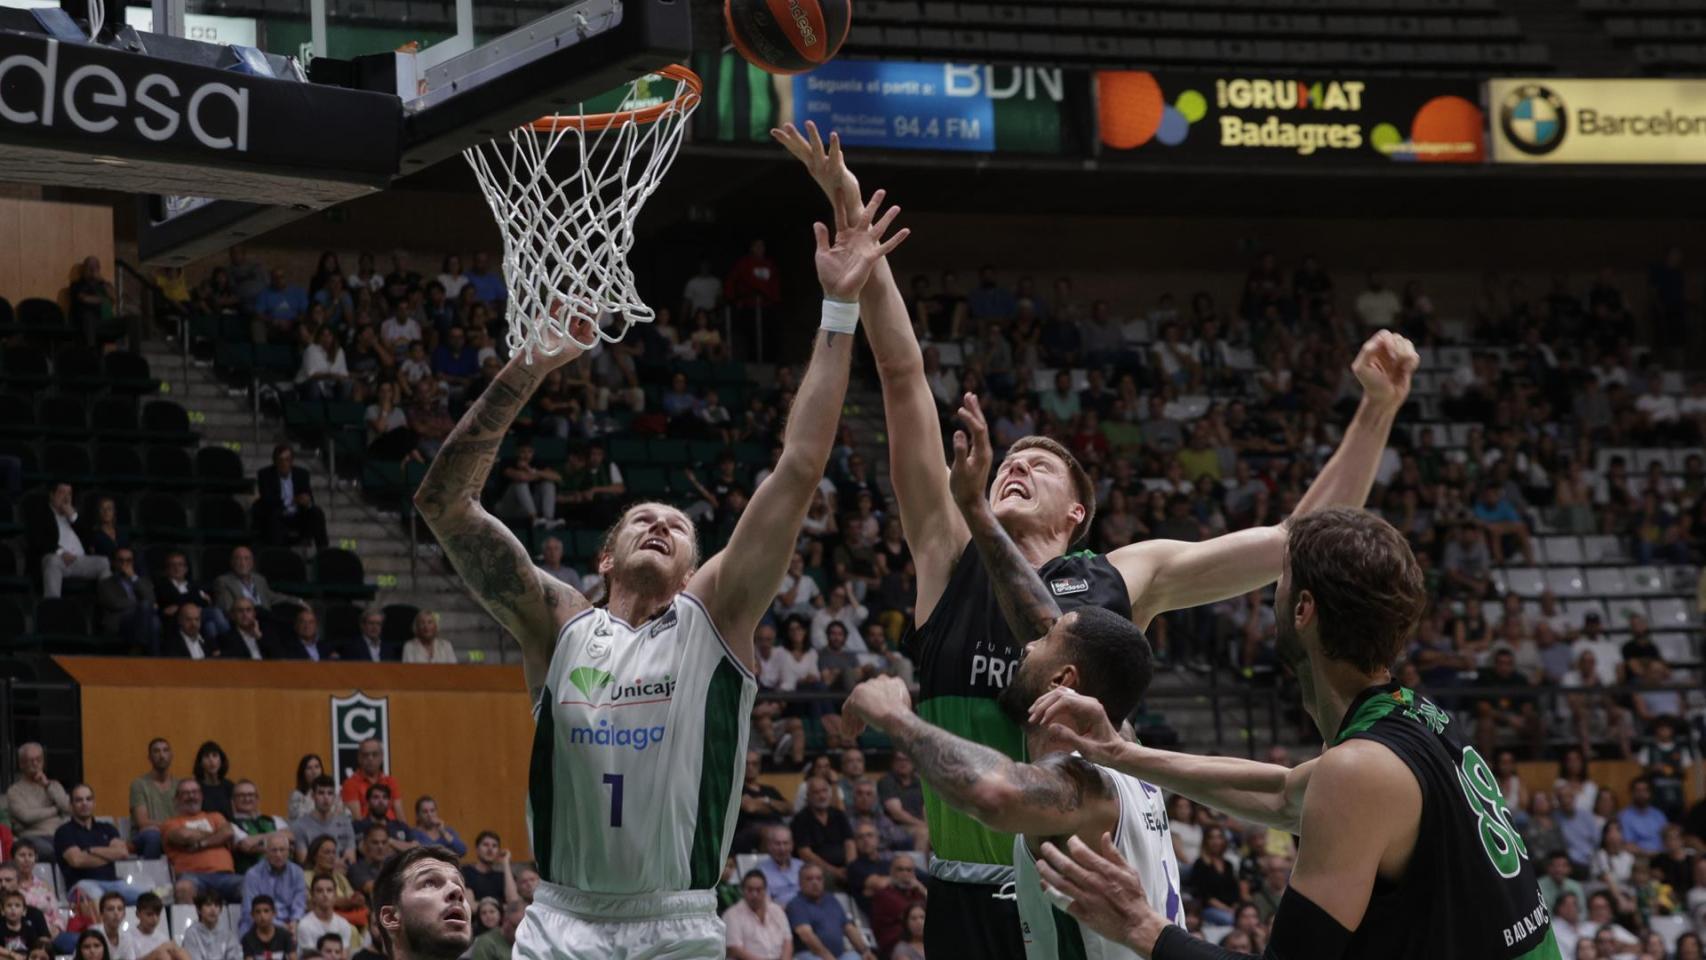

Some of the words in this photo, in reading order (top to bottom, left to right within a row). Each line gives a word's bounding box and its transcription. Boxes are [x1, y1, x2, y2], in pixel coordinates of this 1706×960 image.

[0, 38, 249, 152] desa
[943, 62, 1063, 101] BDN
[893, 116, 939, 138] 94.4
[946, 117, 980, 139] FM
[1219, 117, 1363, 154] Badagres
[602, 773, 625, 828] 1
